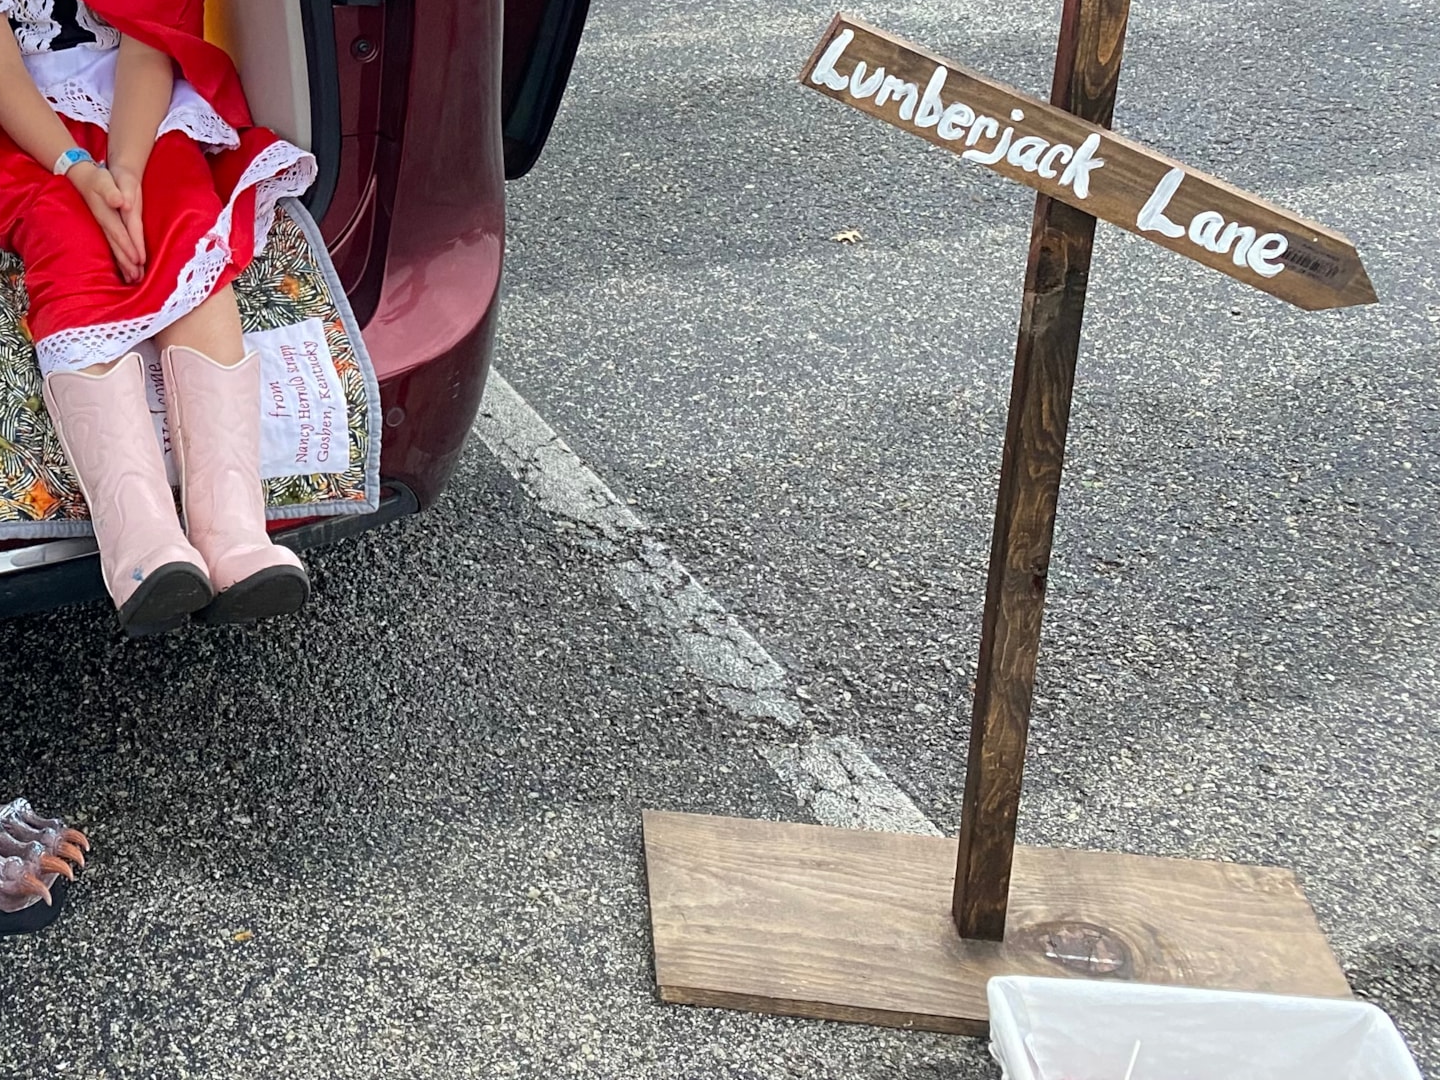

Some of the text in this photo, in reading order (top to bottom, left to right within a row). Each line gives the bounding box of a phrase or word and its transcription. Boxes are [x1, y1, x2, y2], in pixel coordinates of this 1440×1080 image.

[811, 28, 1289, 278] Lumberjack Lane
[268, 381, 292, 418] from
[299, 340, 336, 463] Goshen, Kentucky
[295, 424, 315, 464] Nancy
